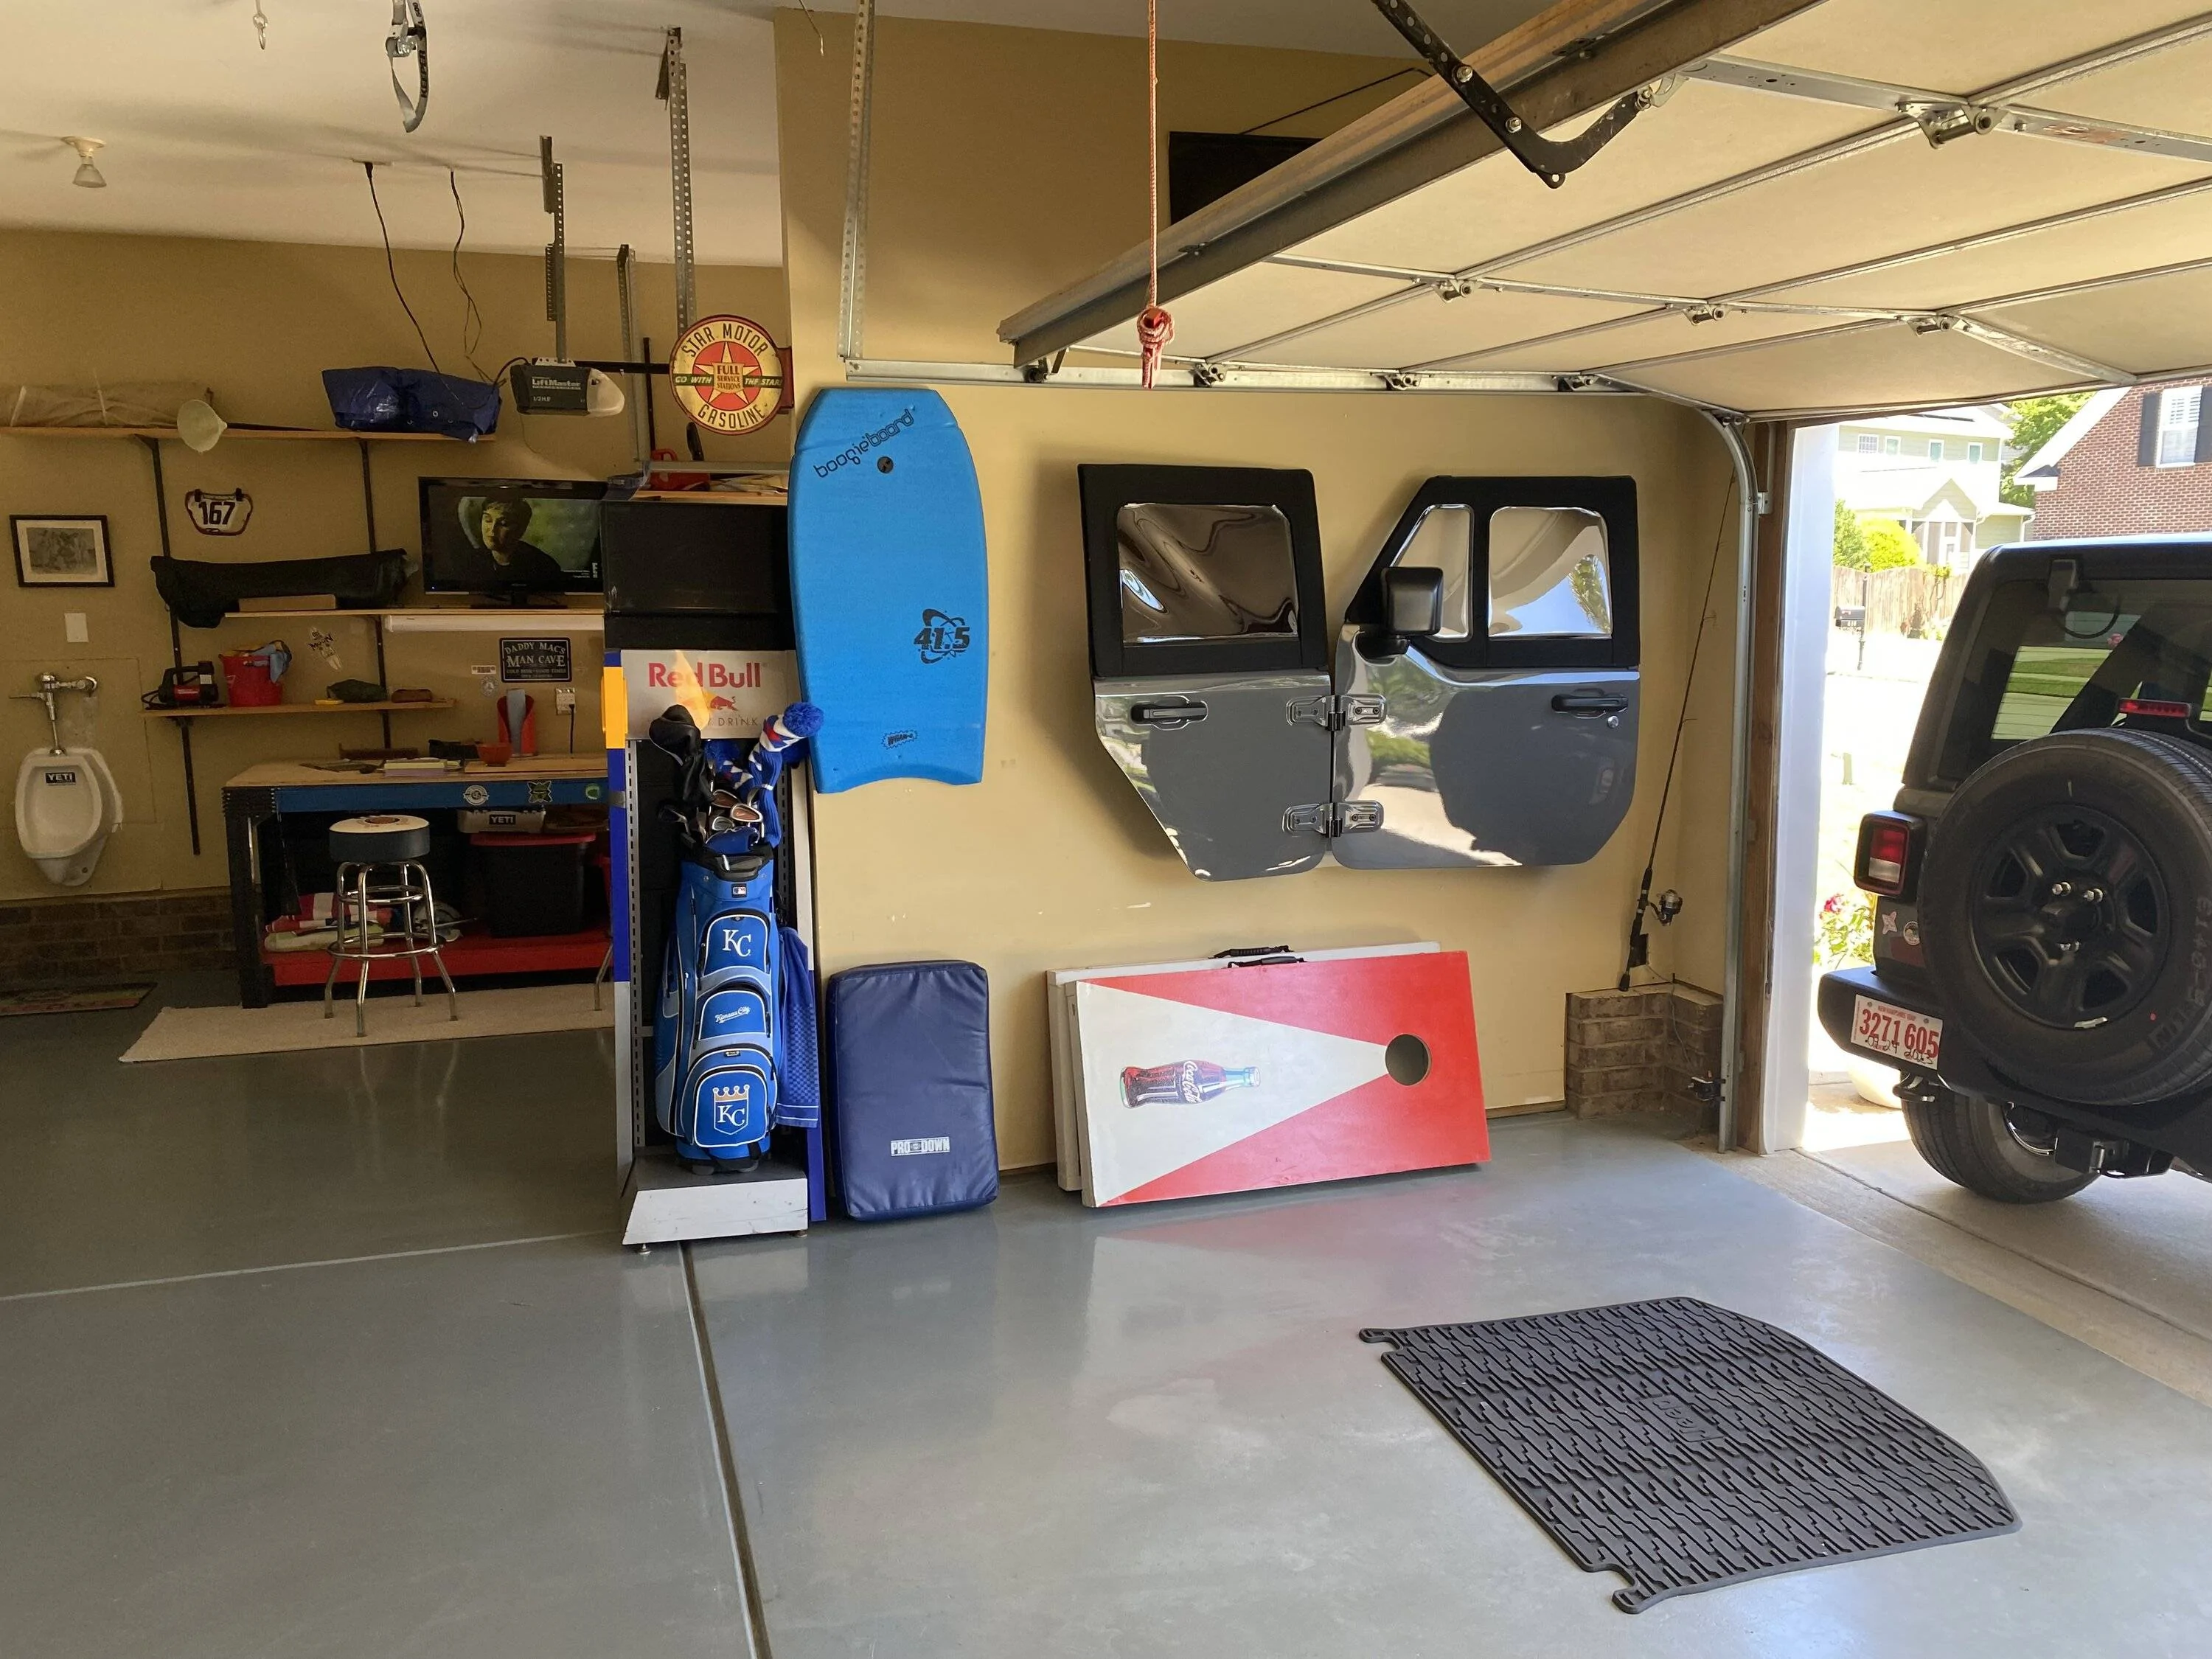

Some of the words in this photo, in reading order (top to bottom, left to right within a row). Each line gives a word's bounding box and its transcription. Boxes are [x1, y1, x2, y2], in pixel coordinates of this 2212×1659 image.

[681, 327, 715, 357] STAR
[723, 323, 768, 356] MOTOR
[717, 365, 740, 375] FULL
[532, 378, 581, 387] LiftMaster
[691, 376, 712, 384] WITH
[717, 382, 741, 391] STATIONS
[698, 404, 765, 429] GASOLINE
[813, 408, 914, 478] boogieboard
[198, 501, 235, 525] 167
[914, 626, 970, 650] 41.5
[504, 642, 535, 654] DADDY
[507, 655, 534, 667] MAN
[538, 655, 566, 667] CAVE
[648, 662, 703, 687] Red
[709, 662, 761, 688] Bull
[718, 717, 758, 726] DRINK
[491, 815, 513, 824] YETI
[723, 929, 751, 957] KC
[1860, 1009, 1902, 1046] 3271
[1905, 1023, 1940, 1058] 605
[717, 1105, 745, 1127] KC
[891, 1141, 910, 1155] PRO
[921, 1138, 950, 1152] DOWN
